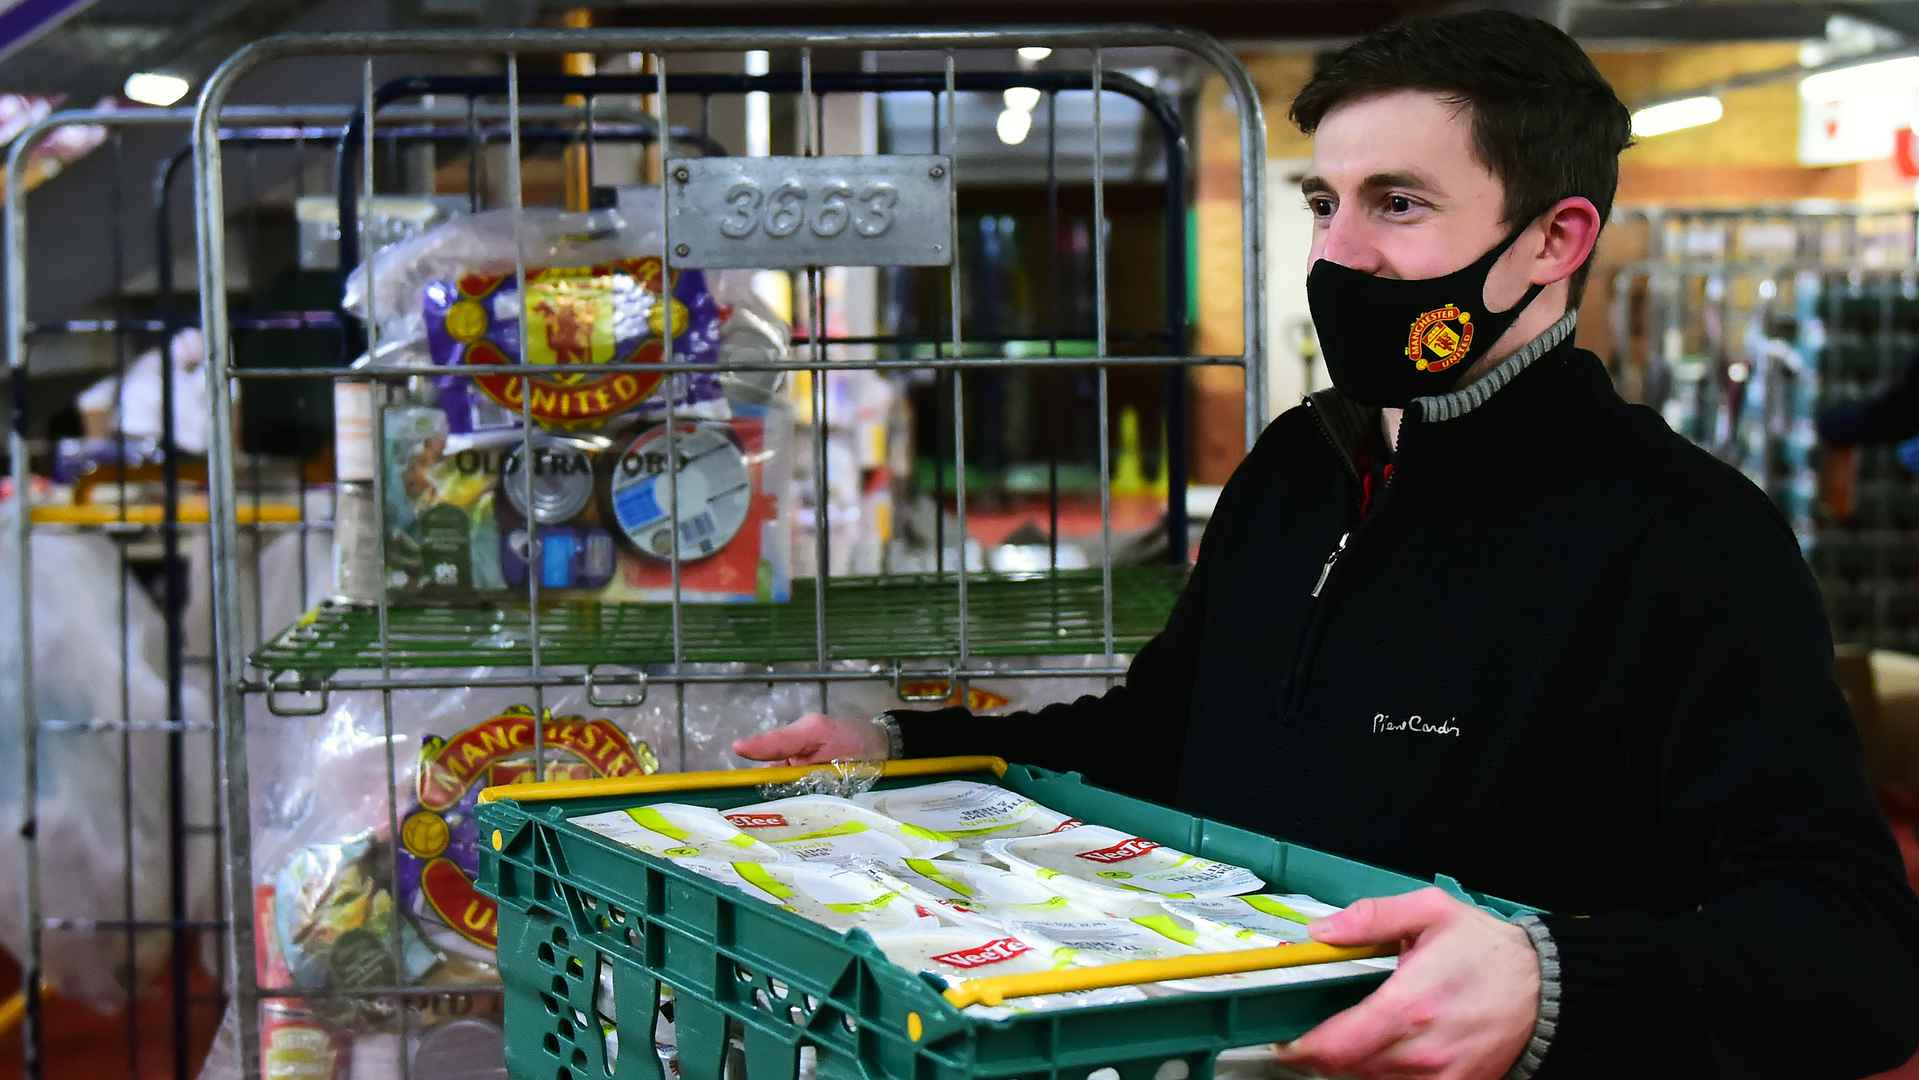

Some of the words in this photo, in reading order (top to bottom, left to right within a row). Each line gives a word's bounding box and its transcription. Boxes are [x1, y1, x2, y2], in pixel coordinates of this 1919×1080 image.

[720, 178, 898, 239] 3663
[1411, 310, 1454, 355] MANCHESTER
[1441, 334, 1471, 368] UNITED
[504, 374, 638, 415] UNITED
[1408, 715, 1460, 737] Cardin
[942, 938, 1027, 966] VeeTe
